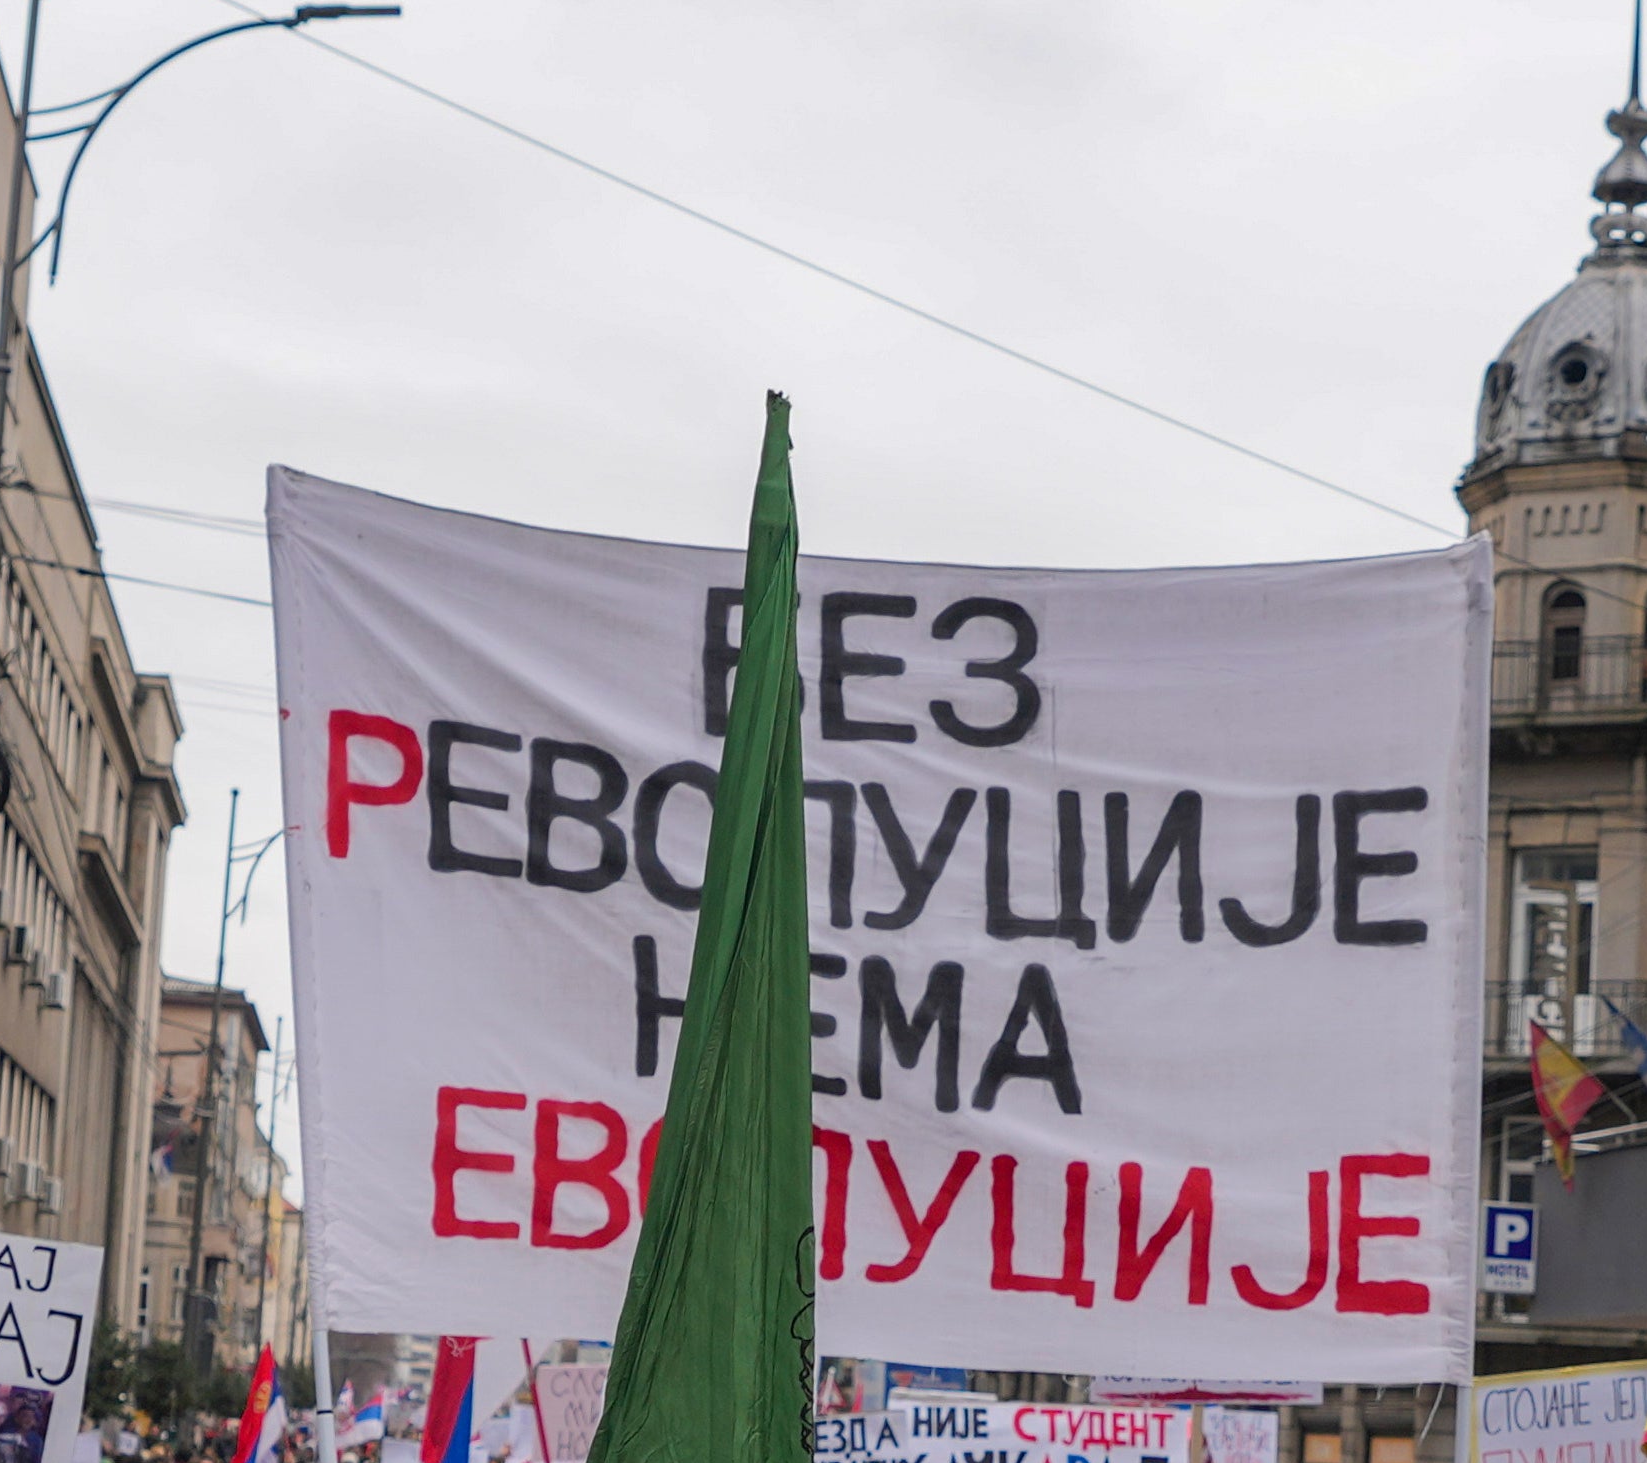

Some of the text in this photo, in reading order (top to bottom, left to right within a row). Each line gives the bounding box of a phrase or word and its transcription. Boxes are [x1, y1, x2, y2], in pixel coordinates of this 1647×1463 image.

[1494, 1213, 1530, 1256] P
[550, 1368, 607, 1398] СЛО
[912, 1406, 1174, 1451] НИЈЕ СТУДЕНТ
[1482, 1381, 1592, 1436] СТОЈАНЕ
[815, 1417, 900, 1459] ЕЗДА
